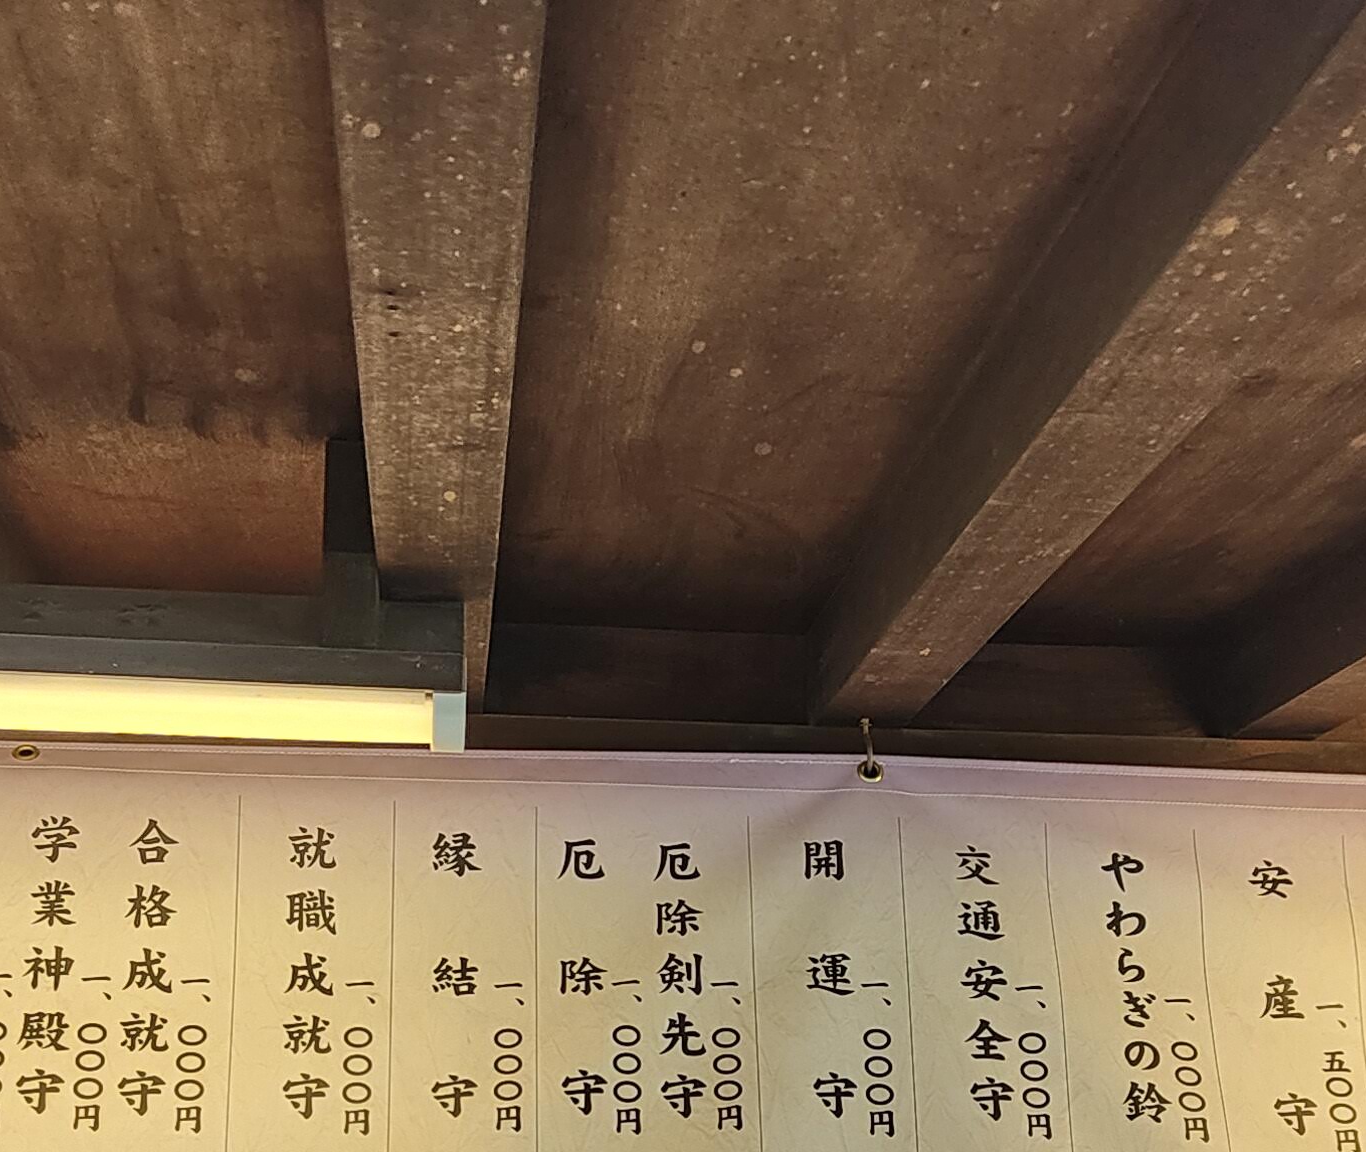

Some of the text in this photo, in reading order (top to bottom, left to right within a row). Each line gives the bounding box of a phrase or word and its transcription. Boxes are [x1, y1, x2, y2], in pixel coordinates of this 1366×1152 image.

[15, 815, 81, 1115] 学業神殿守
[117, 818, 180, 1117] 合格成就守
[282, 826, 337, 1120] 就職成就守
[431, 832, 482, 1118] 縁結守
[557, 838, 609, 1116] 厄除守
[653, 842, 708, 1119] 厄除剣先守
[803, 839, 858, 1119] 開運守
[955, 845, 1015, 1122] 交通安全守
[1100, 852, 1173, 1124] やわらぎの鈴
[1248, 859, 1318, 1136] 安産守
